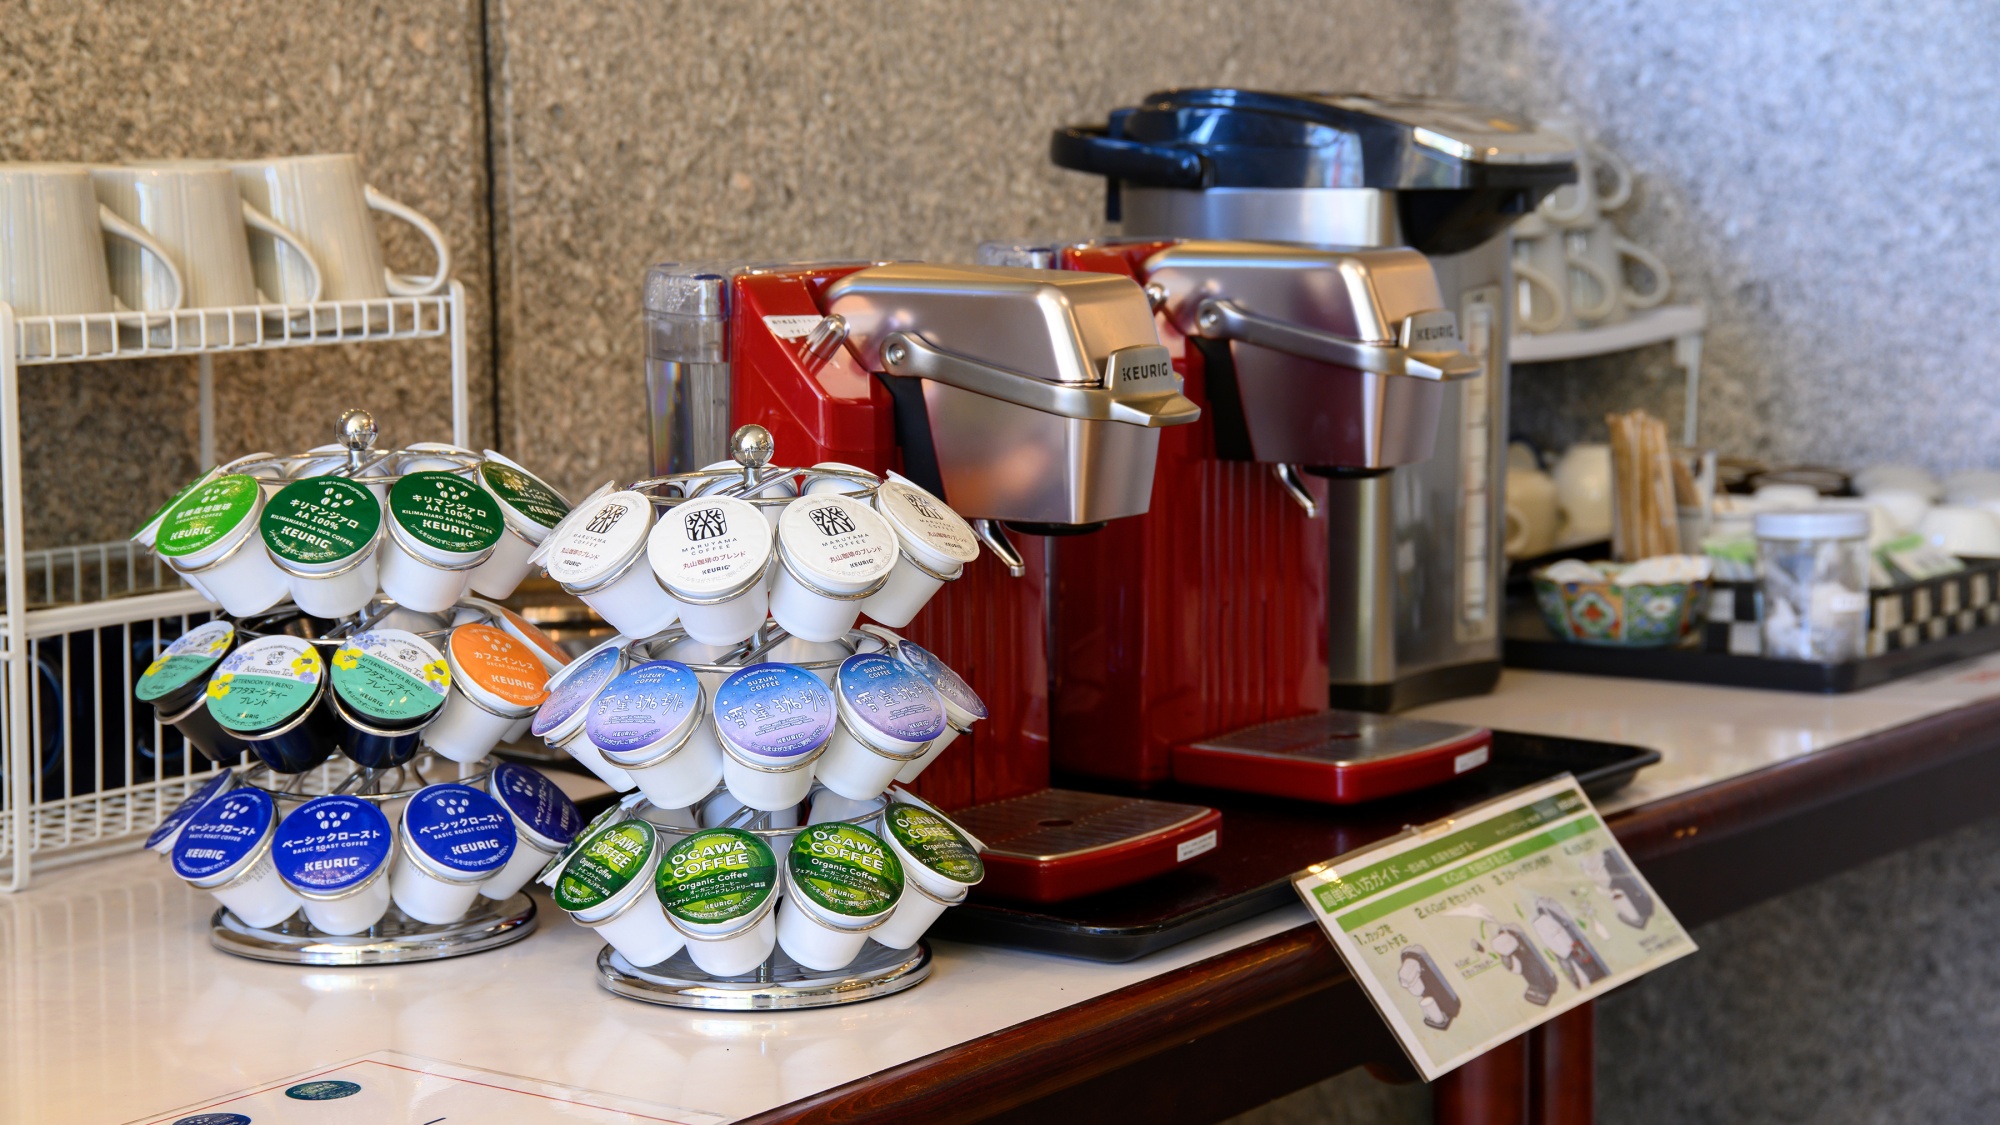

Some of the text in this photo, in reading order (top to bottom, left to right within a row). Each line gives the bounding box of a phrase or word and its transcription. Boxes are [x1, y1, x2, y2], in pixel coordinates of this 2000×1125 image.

[1122, 362, 1168, 382] KEURIG
[426, 504, 472, 520] AA 100%
[295, 510, 340, 530] AA 100%
[402, 510, 444, 520] KILIMANJARO
[471, 523, 493, 534] COFFEE
[170, 526, 214, 540] KEURIG
[270, 514, 308, 528] KILIMANJARO
[316, 528, 331, 537] 100%
[332, 534, 355, 548] COFFEE
[422, 519, 476, 538] KEURIG
[281, 526, 332, 549] KEURIG
[574, 540, 598, 548] COFFEE
[682, 538, 738, 552] MARUYAMA
[822, 533, 870, 547] MARUYAMA
[832, 539, 866, 550] COFFEE
[691, 544, 731, 556] COFFEE
[683, 550, 746, 570] 丸山珈琲のブレンド
[850, 558, 874, 568] KEURIG
[702, 564, 731, 575] KEURIG
[374, 651, 412, 672] Afternoon
[414, 668, 425, 680] Tea
[474, 652, 534, 670] カフェインレス
[243, 666, 294, 677] Afternoon Tea
[361, 658, 422, 692] AFTERNOON TEA BLEND
[864, 665, 886, 674] SUZUKI
[868, 670, 892, 678] COFFEE
[232, 678, 262, 686] AFTERNOON
[274, 682, 294, 690] BLEND
[366, 678, 396, 696] ブレンド
[491, 674, 534, 690] KEURIG
[748, 676, 777, 686] SUZUKI
[750, 681, 780, 692] COFFEE
[240, 697, 269, 706] ブレンド
[360, 692, 384, 706] KEURIG
[776, 732, 805, 744] KEURIG
[896, 816, 942, 828] OGAWA
[434, 832, 453, 840] BASIC
[908, 827, 954, 838] COFFEE
[292, 840, 368, 854] BASIC ROAST COFFEE
[451, 839, 499, 855] KEURIG
[604, 830, 643, 856] OGAWA
[813, 830, 884, 858] OGAWA
[185, 848, 226, 860] KEURIG
[592, 842, 631, 868] COFFEE
[672, 840, 747, 865] OGAWA
[811, 842, 884, 870] COFFEE
[304, 857, 360, 872] KEURIG
[580, 857, 612, 880] Organic Coffee
[674, 853, 749, 878] COFFEE
[812, 858, 878, 882] Organic Coffee
[678, 872, 748, 892] Organic Coffee
[1319, 864, 1400, 908] 簡単使い方ガイド
[828, 888, 856, 899] KEURIG
[704, 900, 733, 910] KEURIG
[1374, 934, 1408, 954] セットする
